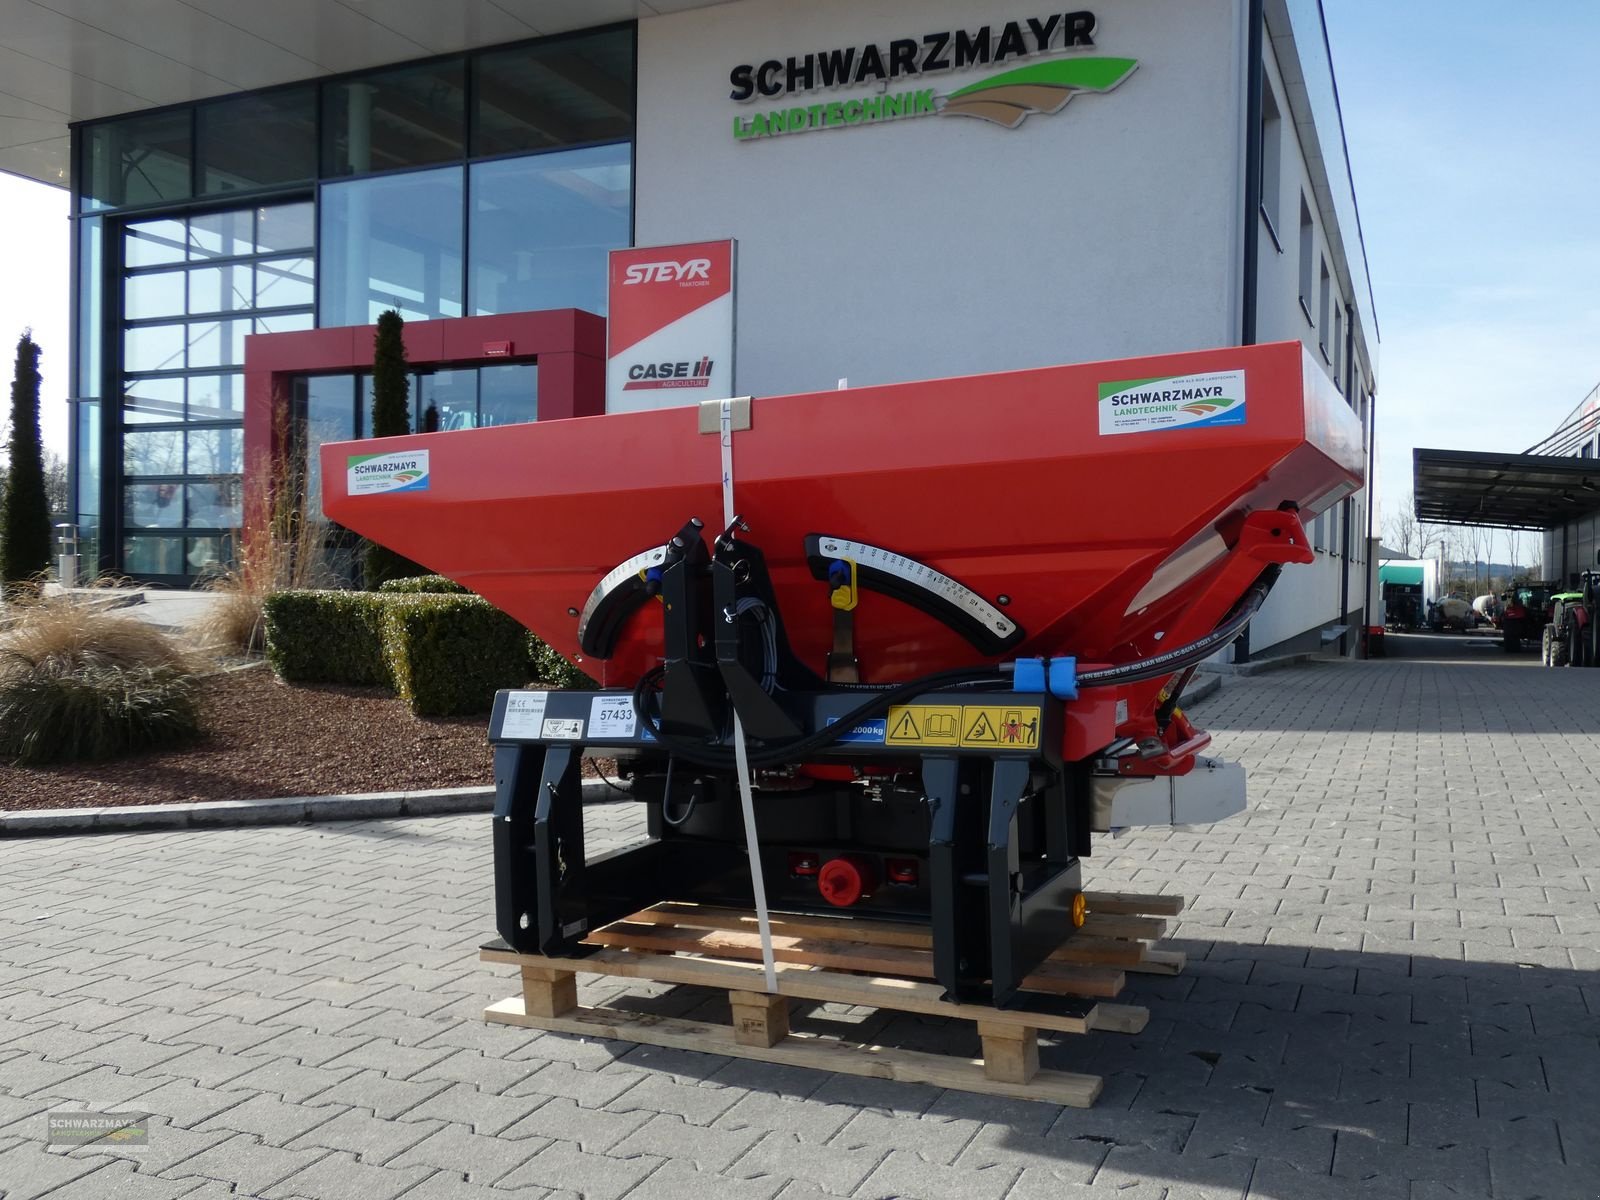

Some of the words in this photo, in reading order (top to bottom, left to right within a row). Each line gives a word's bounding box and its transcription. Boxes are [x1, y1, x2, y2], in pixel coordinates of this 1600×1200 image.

[730, 10, 1097, 100] SCHWARZMAYR
[733, 88, 936, 139] LANDTECHNIK
[622, 258, 711, 285] STEYR
[679, 280, 710, 288] TRAKTOREN
[628, 362, 689, 380] CASE
[662, 379, 707, 388] AGRICULTURE
[1111, 386, 1223, 406] SCHWARZMAYR
[1114, 404, 1178, 416] LANDTECHNIK
[355, 461, 417, 474] SCHWARZMAYR
[356, 474, 392, 482] LANDTECHNIK
[1142, 659, 1155, 668] BAR
[600, 709, 633, 720] 57433
[852, 726, 873, 734] 2000
[873, 727, 884, 736] kg
